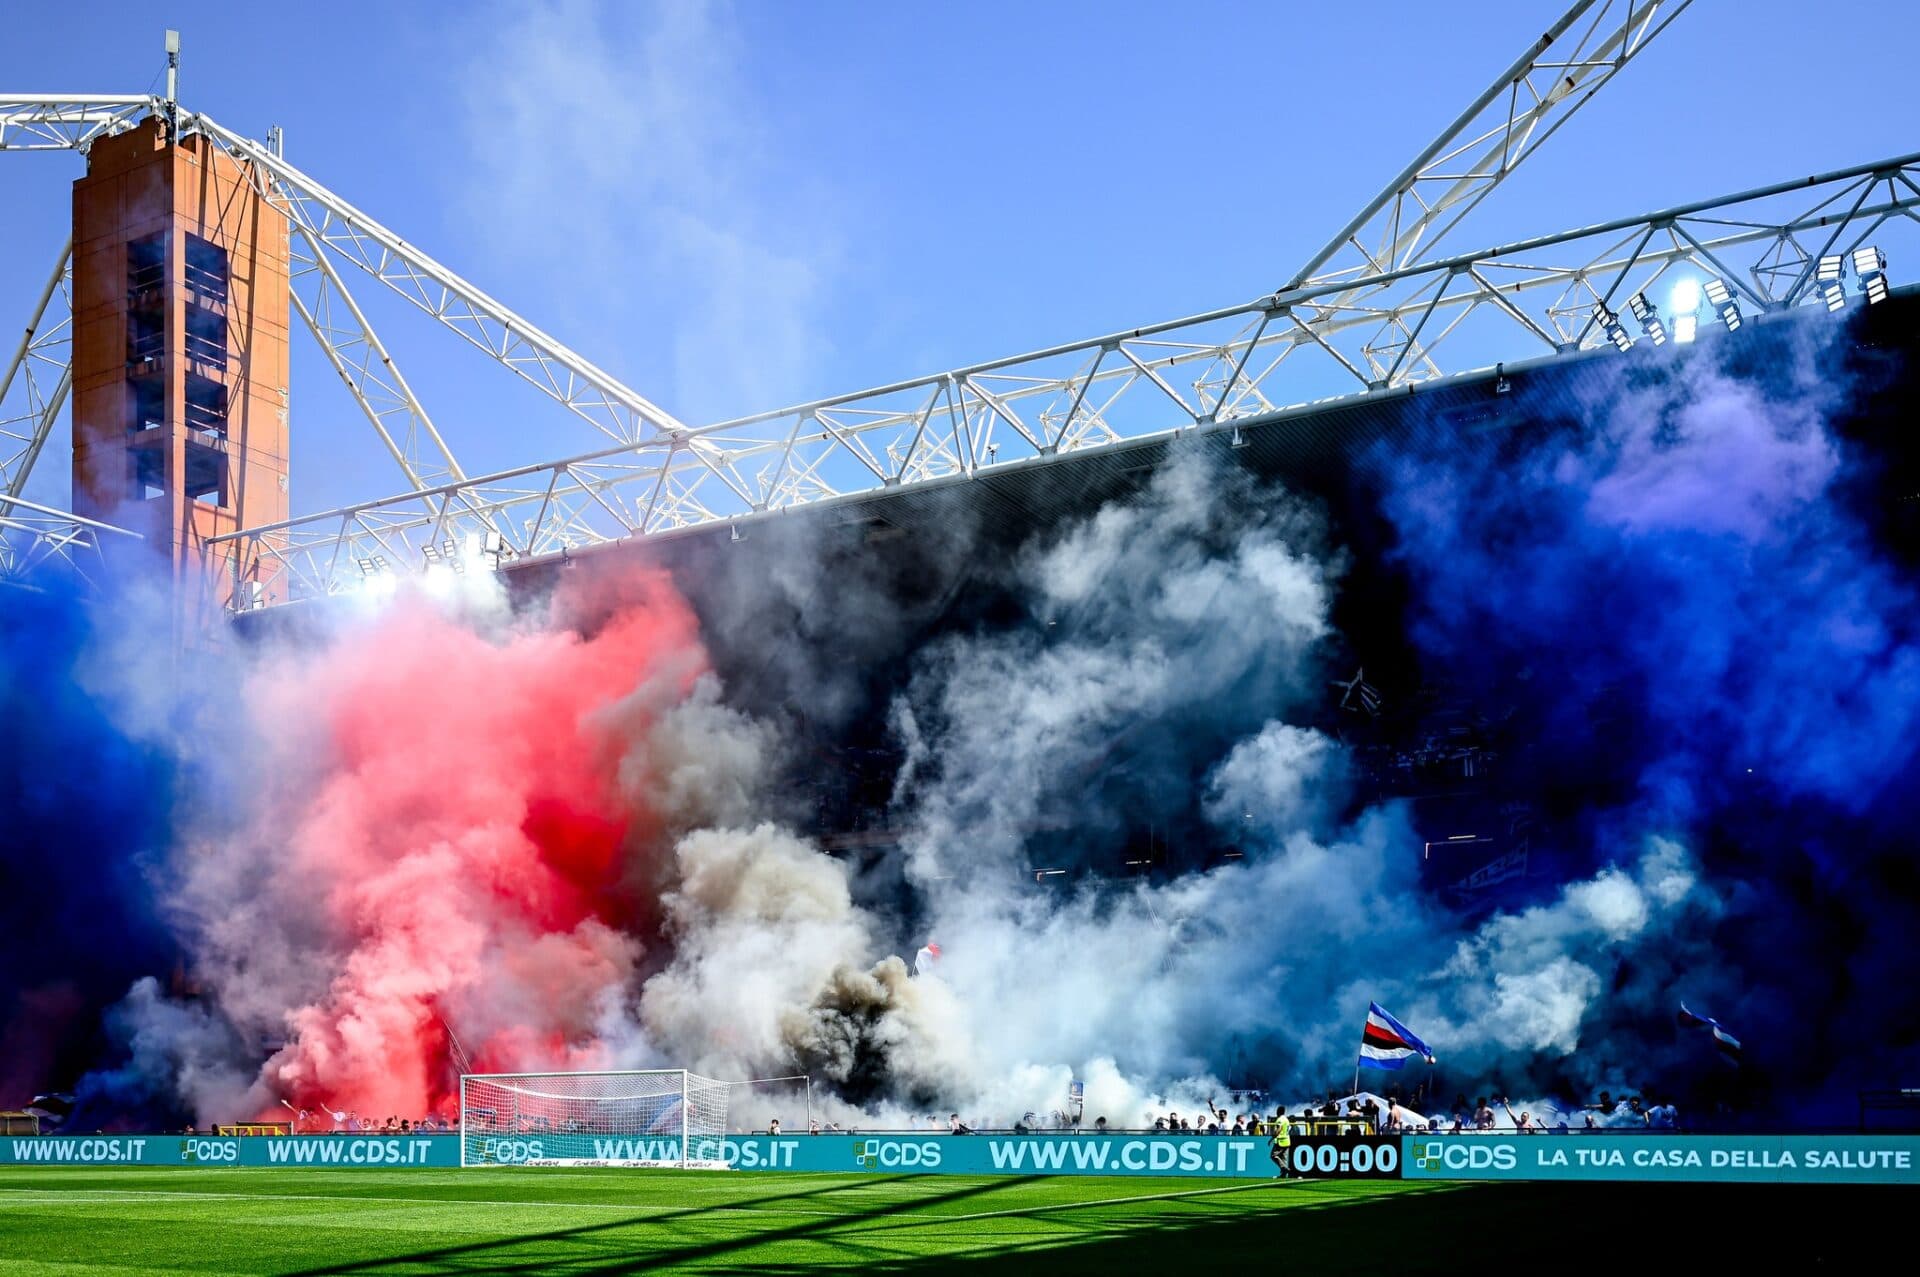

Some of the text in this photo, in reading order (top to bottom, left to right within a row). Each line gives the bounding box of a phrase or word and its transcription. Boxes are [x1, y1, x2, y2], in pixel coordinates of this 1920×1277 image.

[13, 1139, 146, 1161] WWW.CDS.IT
[197, 1141, 237, 1161] CDS
[268, 1140, 432, 1164] WWW.CDS.IT
[496, 1140, 544, 1163] CDS
[593, 1138, 799, 1168] WWWCDS.IT
[879, 1141, 941, 1167] CDS
[989, 1140, 1255, 1172] WWW.CDS.IT
[1293, 1144, 1398, 1172] 00:00
[1443, 1143, 1517, 1170] CDS
[1537, 1149, 1911, 1169] LA TUA CASA DELLA SALUTE
